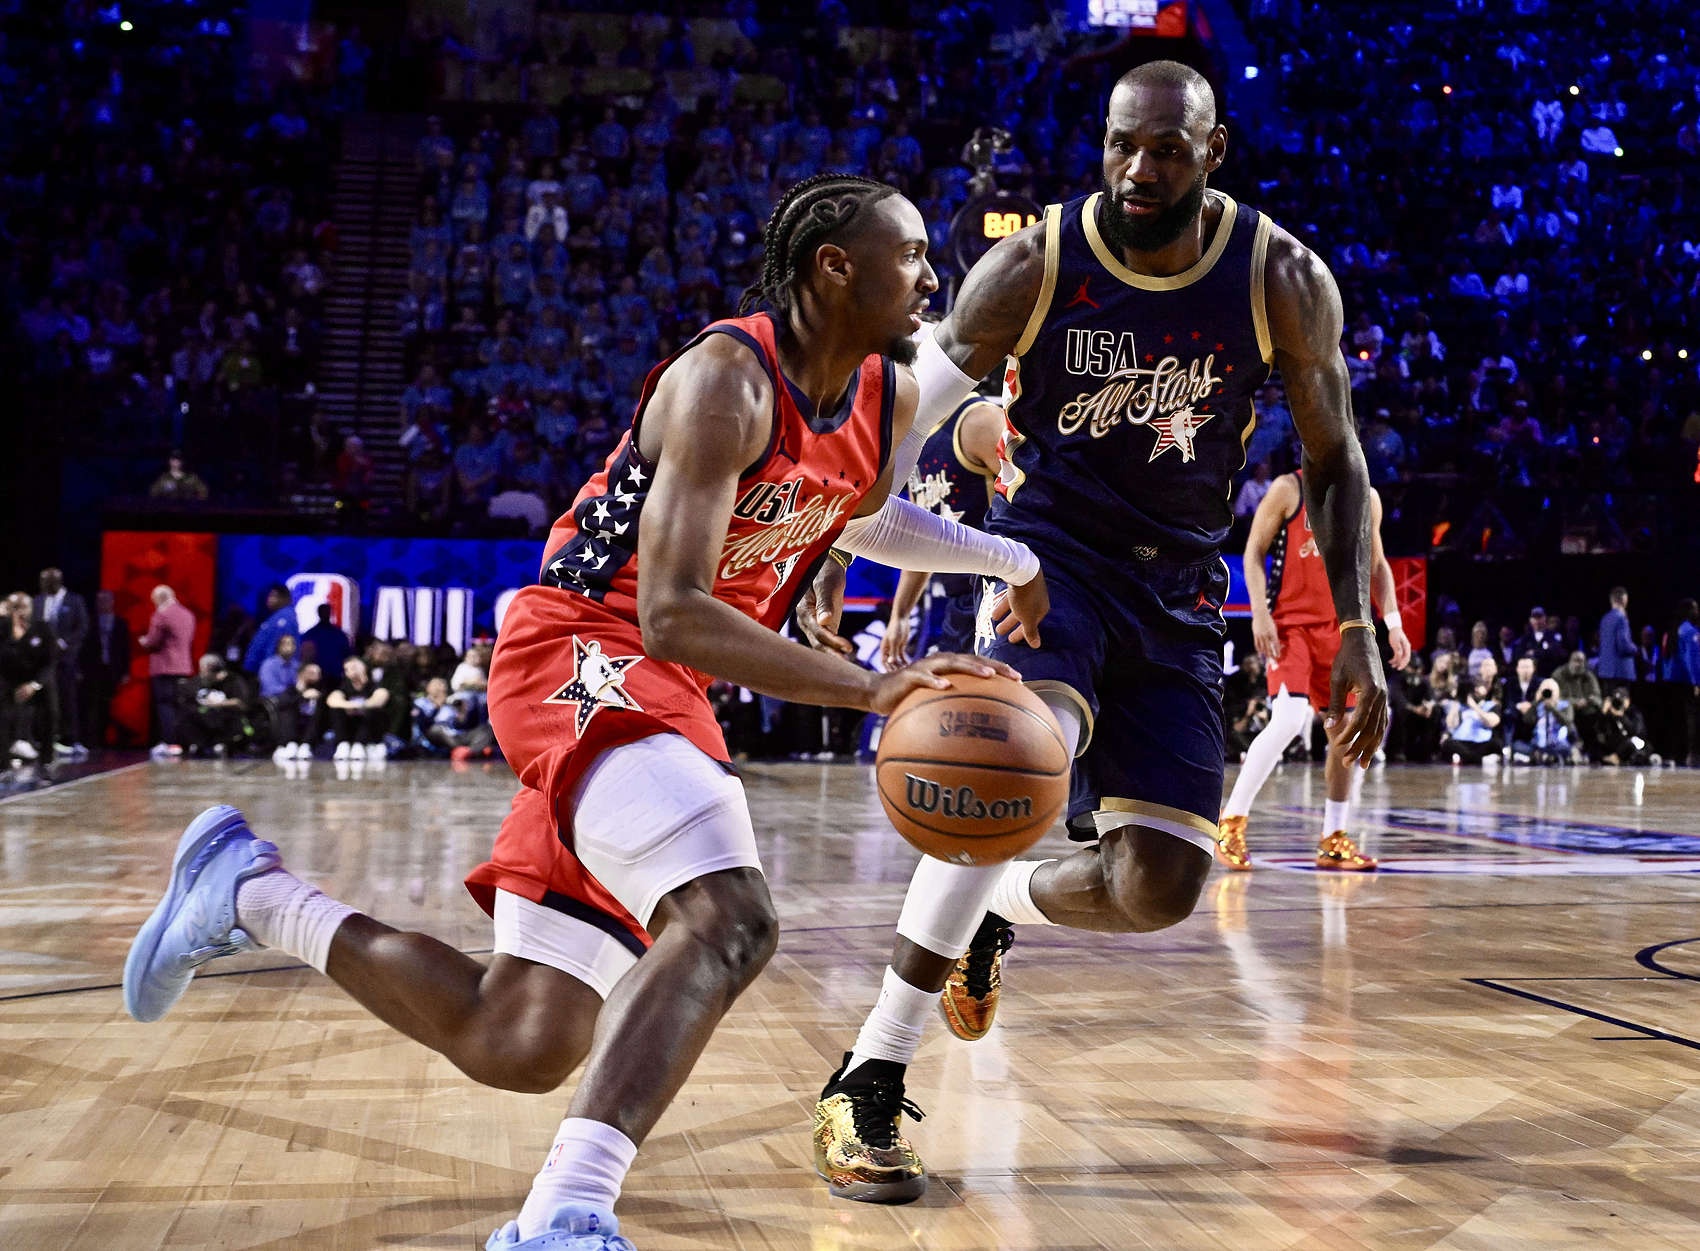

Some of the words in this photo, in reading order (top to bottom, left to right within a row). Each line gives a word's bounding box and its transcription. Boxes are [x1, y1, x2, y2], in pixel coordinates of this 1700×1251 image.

[1065, 329, 1139, 379] USA
[733, 476, 805, 526] USA
[904, 772, 1034, 821] Wilson
